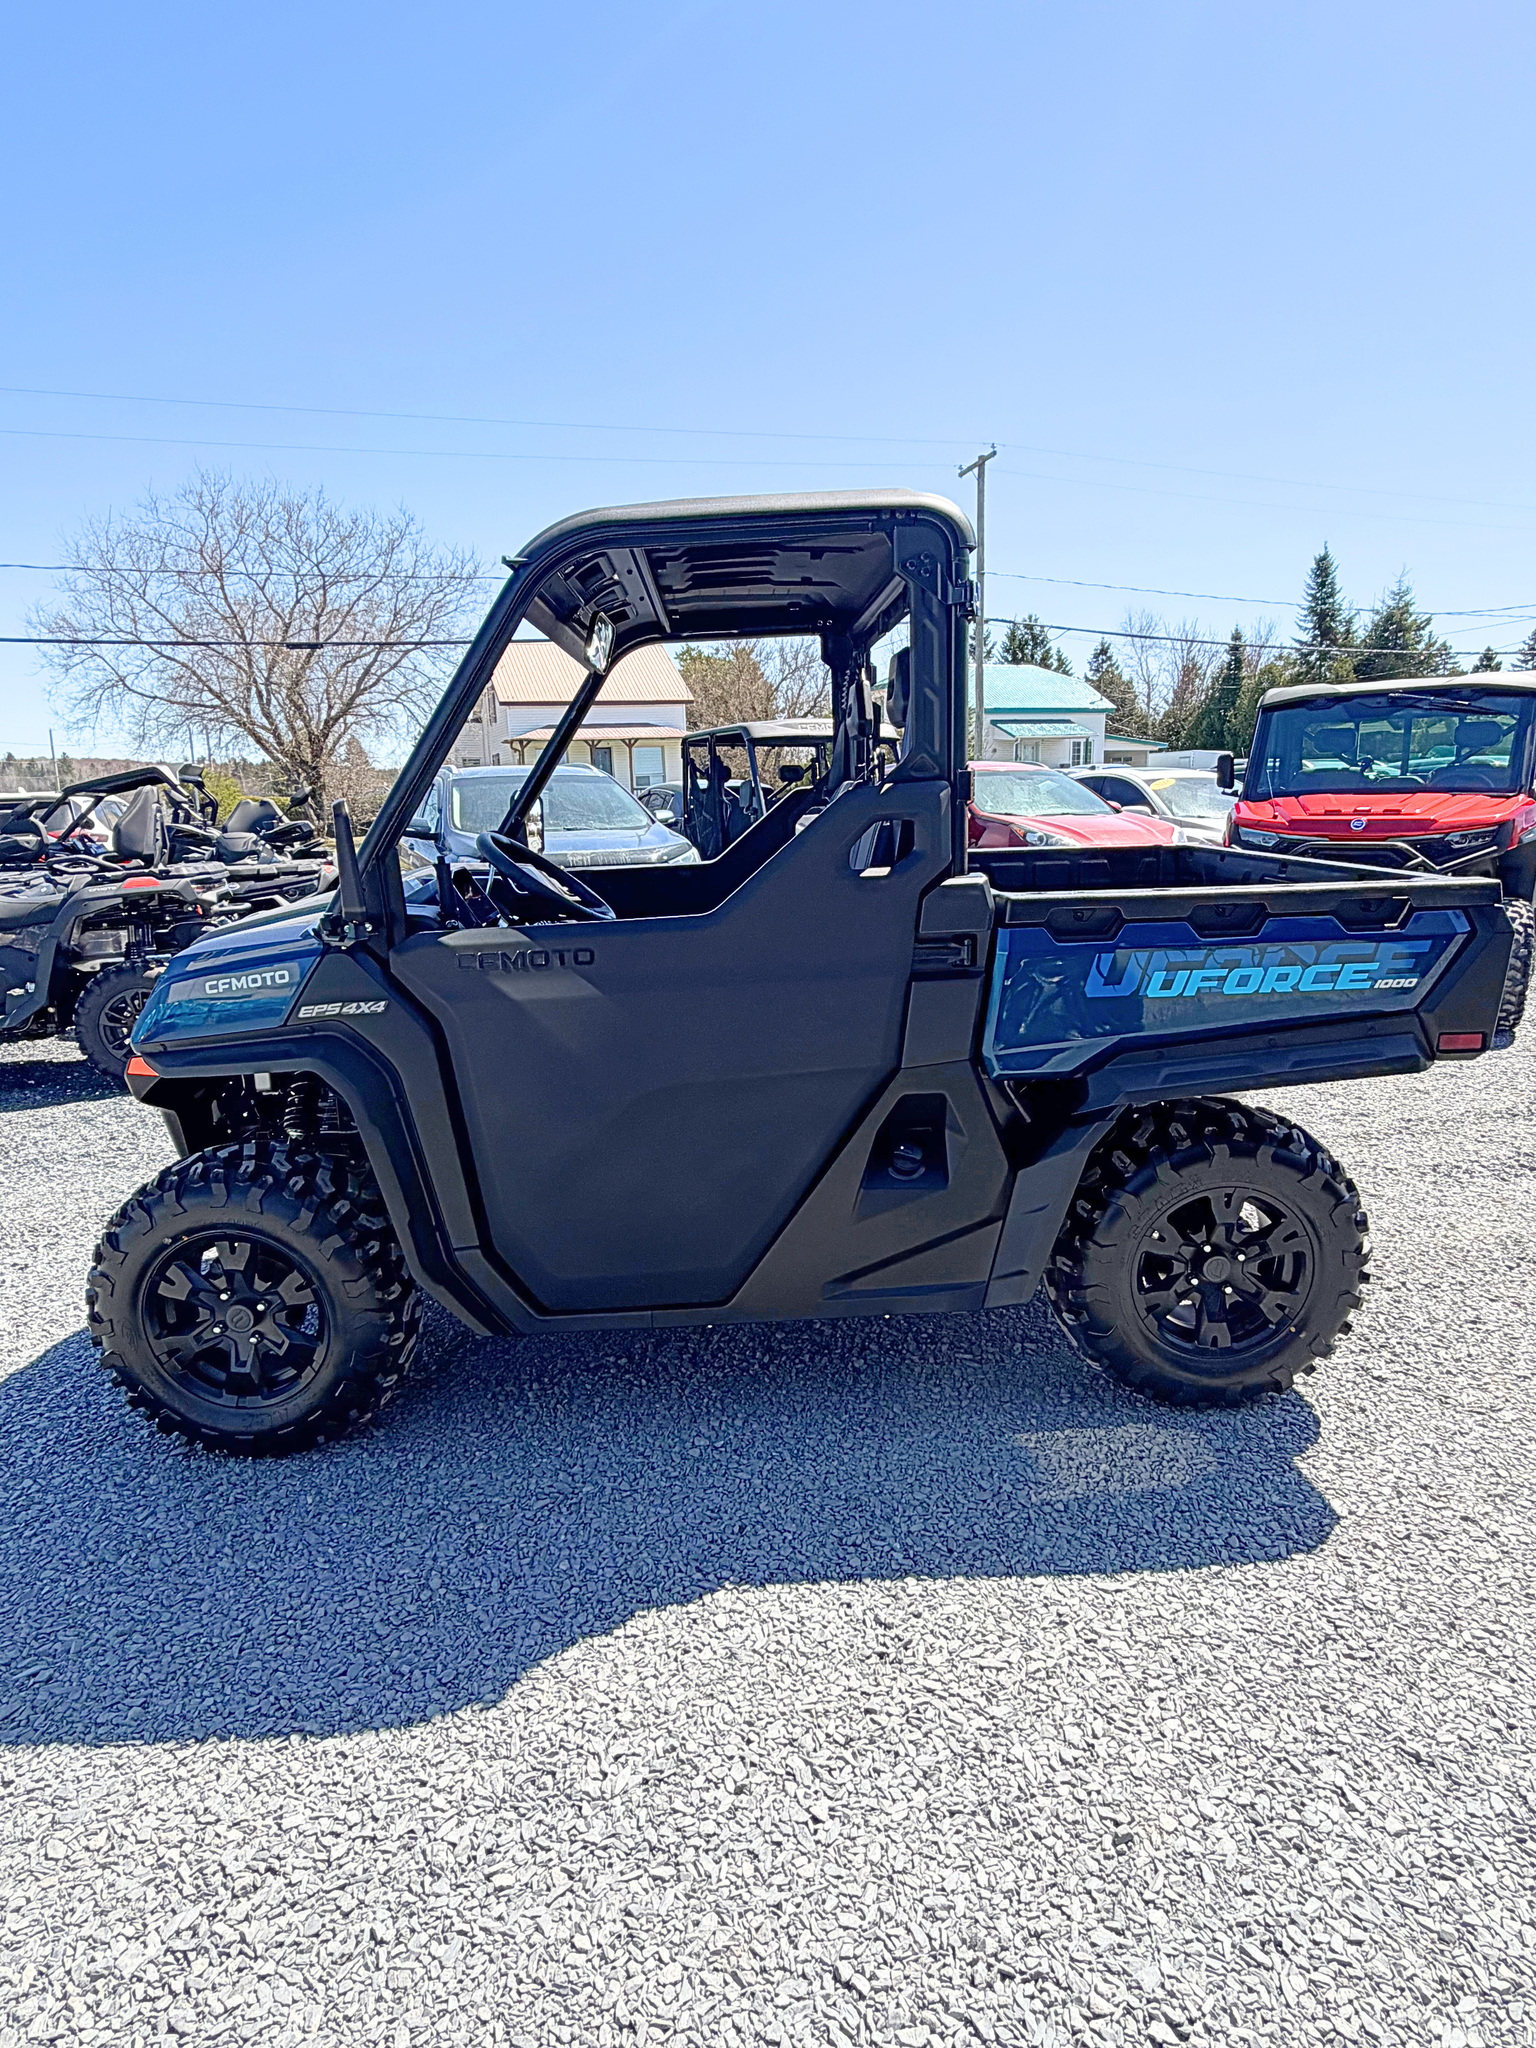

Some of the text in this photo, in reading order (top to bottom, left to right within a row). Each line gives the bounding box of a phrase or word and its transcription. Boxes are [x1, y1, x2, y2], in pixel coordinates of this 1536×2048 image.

[798, 722, 834, 731] CFMO
[456, 948, 595, 973] CFMOTO
[205, 970, 290, 994] CFMOTO
[1146, 963, 1380, 998] UFORCE
[1374, 978, 1418, 989] 1000
